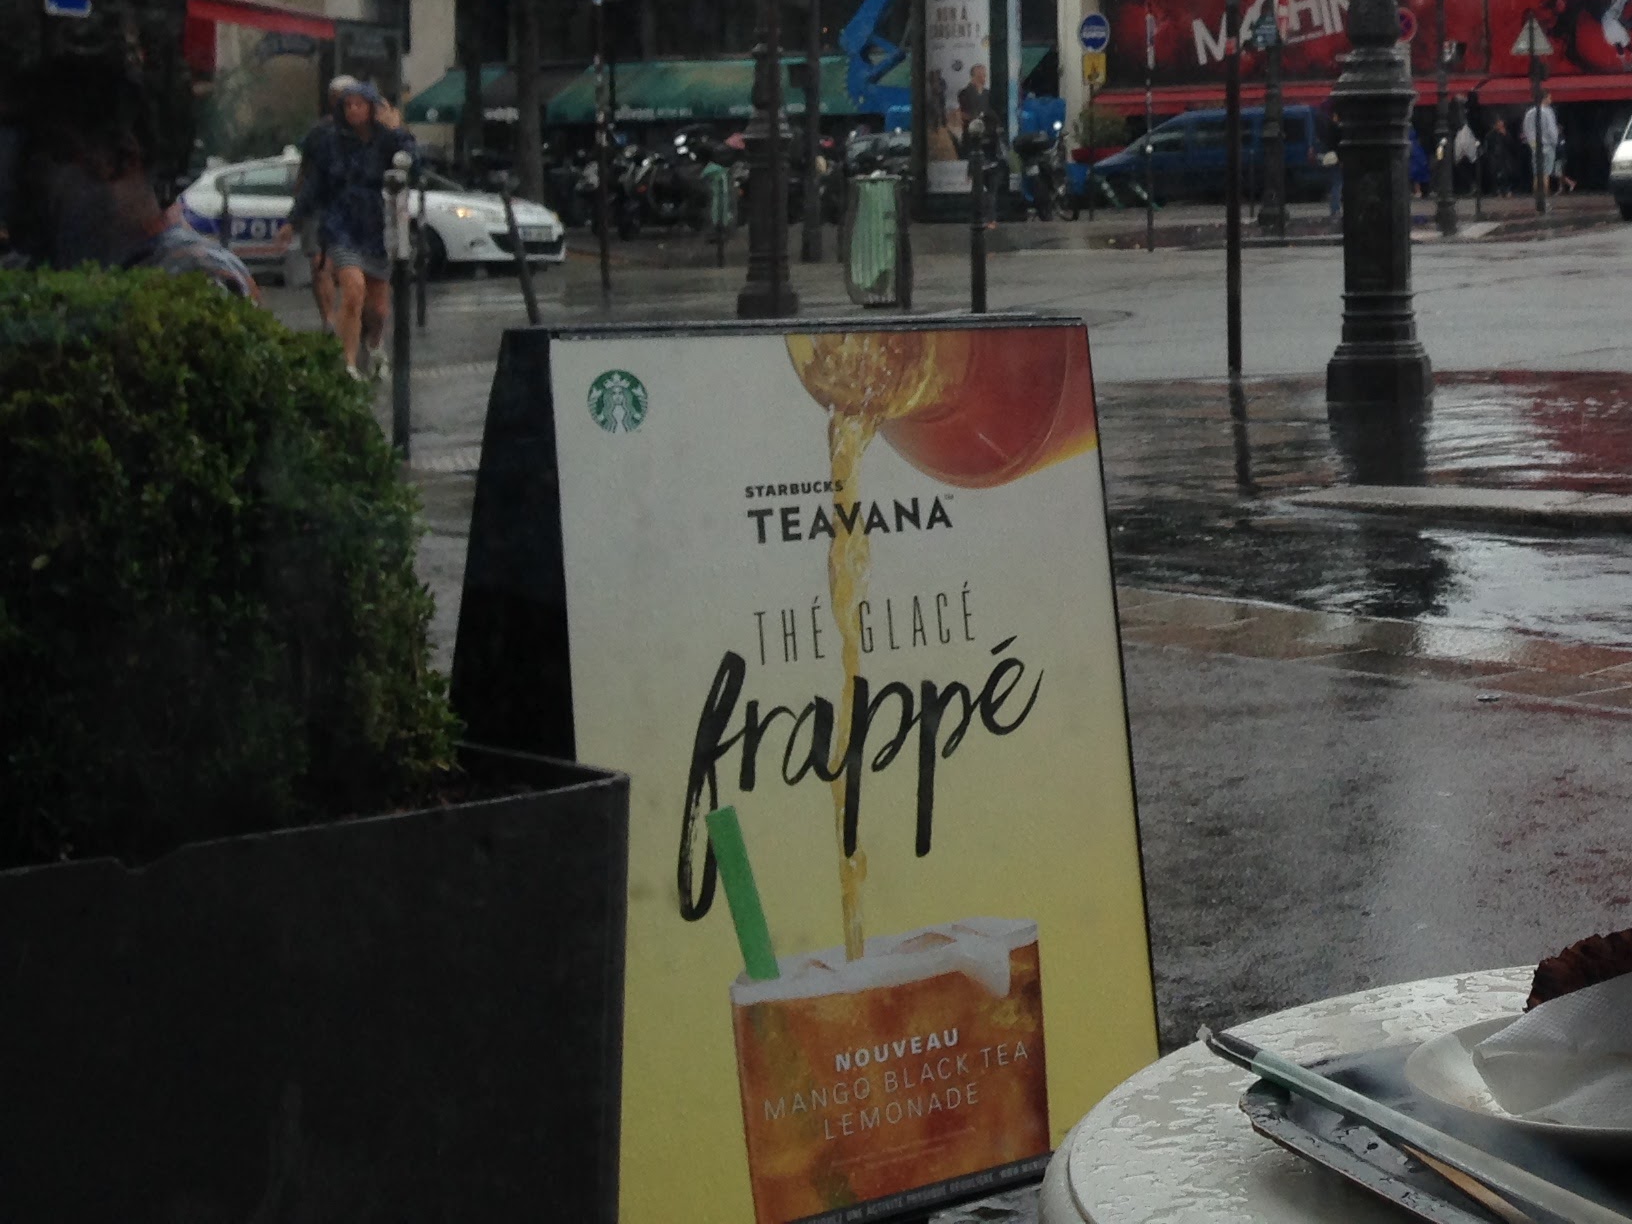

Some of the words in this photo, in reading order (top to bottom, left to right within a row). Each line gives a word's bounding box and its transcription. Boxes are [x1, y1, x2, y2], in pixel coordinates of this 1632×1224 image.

[745, 479, 844, 498] STARBUCKS
[747, 495, 953, 544] TEAVANA
[753, 595, 826, 666] THÉ
[858, 580, 976, 654] GLACÉ
[677, 635, 1044, 921] frappé
[835, 1027, 960, 1073] NOUVEAU
[764, 1075, 871, 1121] MANGO
[884, 1054, 970, 1094] BLACK
[980, 1040, 1030, 1069] TEA
[823, 1081, 980, 1141] LEMONADE
